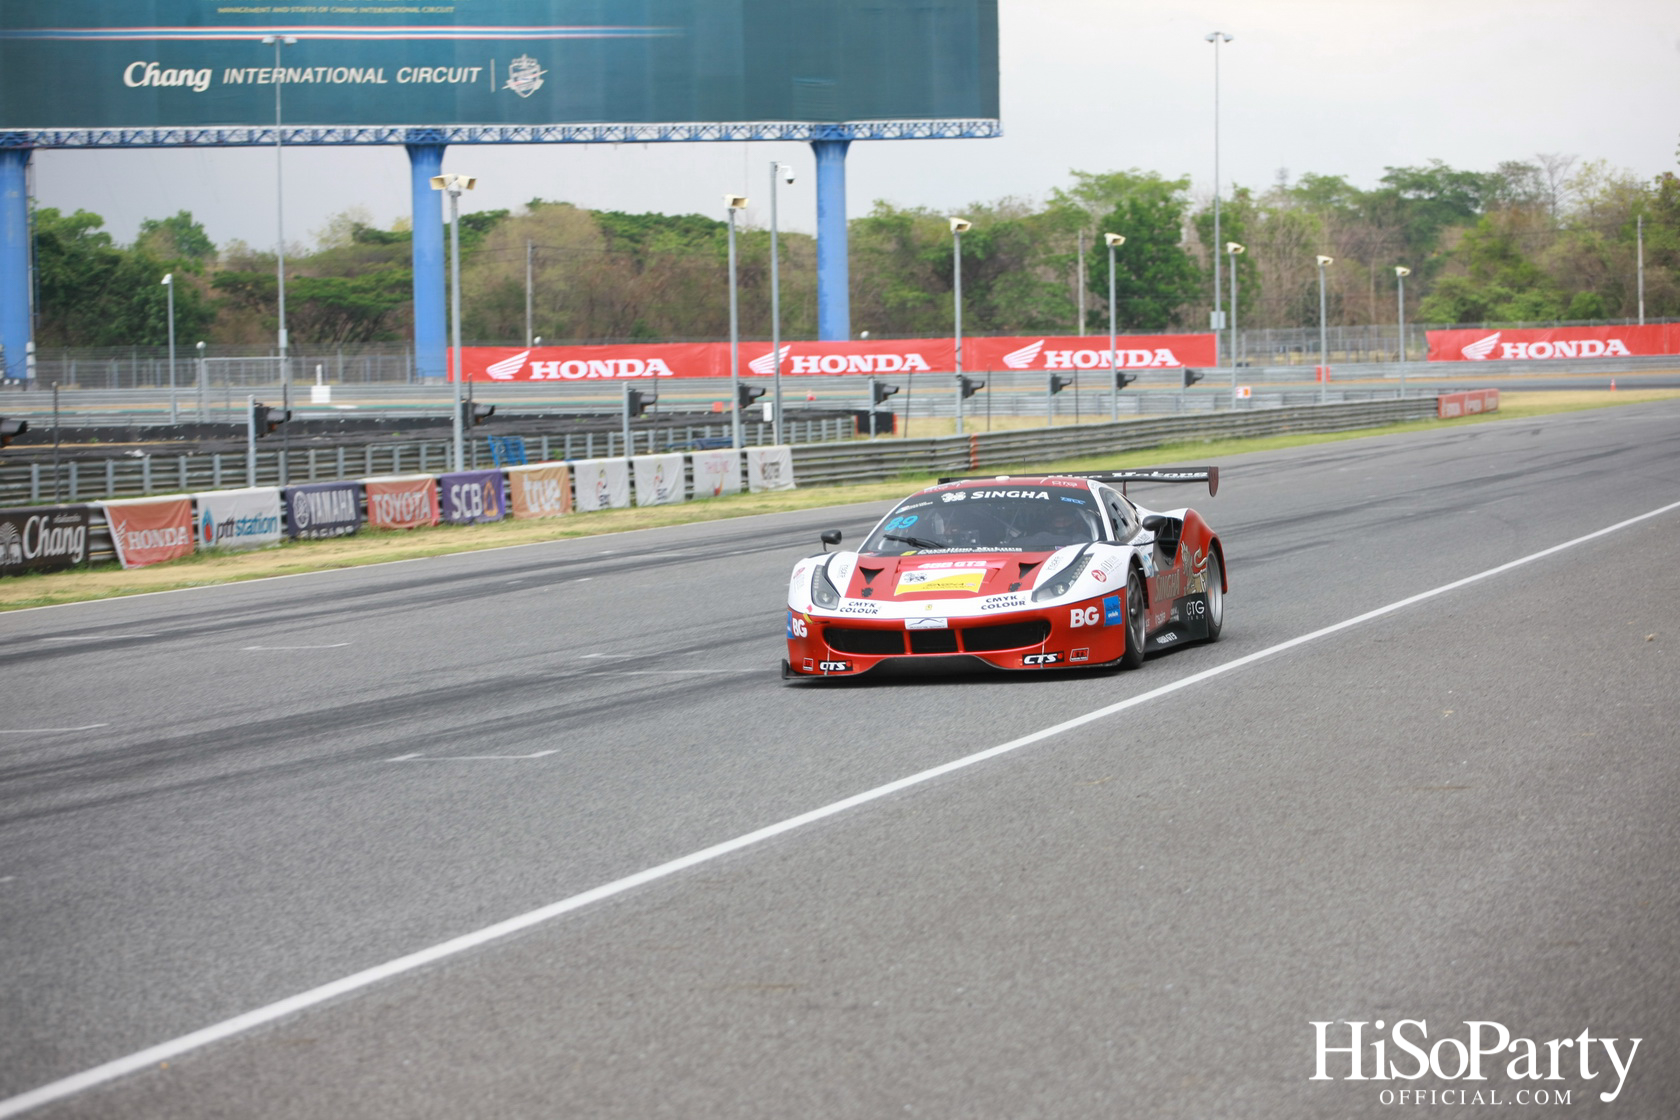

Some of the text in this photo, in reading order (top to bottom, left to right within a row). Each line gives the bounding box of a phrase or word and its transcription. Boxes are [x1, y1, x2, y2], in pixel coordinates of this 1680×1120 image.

[123, 61, 482, 92] Chang INTERNATIONAL CIRCUIT
[1044, 349, 1180, 368] HONDA
[1500, 339, 1631, 359] HONDA
[529, 358, 674, 379] HONDA
[790, 354, 931, 374] HONDA
[451, 483, 482, 519] SCB
[524, 473, 561, 513] true
[970, 491, 1050, 501] SINGHA
[307, 489, 356, 524] YAMAHA
[372, 491, 431, 524] TOYOTA
[235, 513, 277, 537] station
[884, 515, 919, 531] 89
[22, 515, 87, 563] Chang
[127, 526, 190, 550] HONDA
[980, 600, 1026, 611] COLOUR
[985, 595, 1018, 604] CMYK
[1186, 600, 1205, 616] CTG
[840, 607, 878, 615] COLOUR
[1070, 606, 1100, 629] BG
[792, 617, 808, 638] BG
[1023, 653, 1057, 665] CTS
